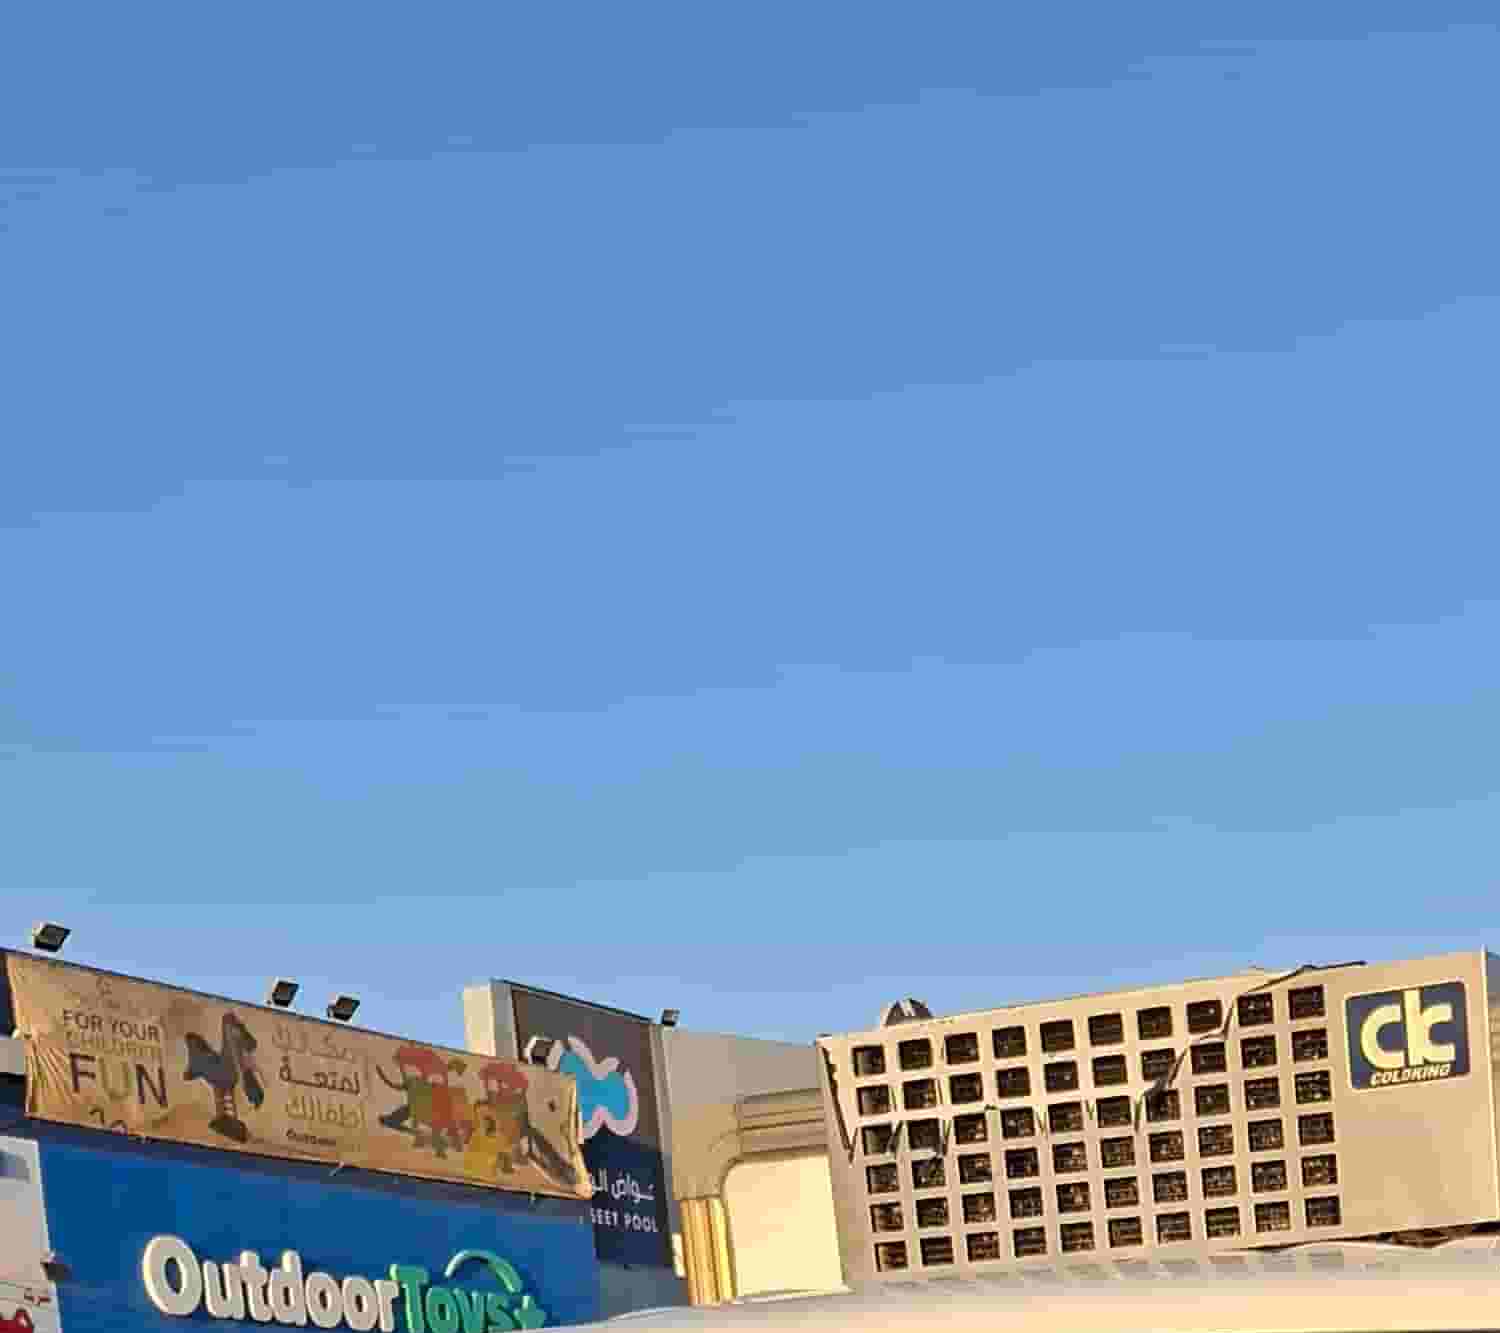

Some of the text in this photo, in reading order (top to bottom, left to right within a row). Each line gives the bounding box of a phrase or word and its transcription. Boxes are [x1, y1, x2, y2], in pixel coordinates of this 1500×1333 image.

[64, 1008, 160, 1042] FOR YOUR
[69, 1052, 168, 1105] FUN
[623, 1212, 659, 1233] POOL
